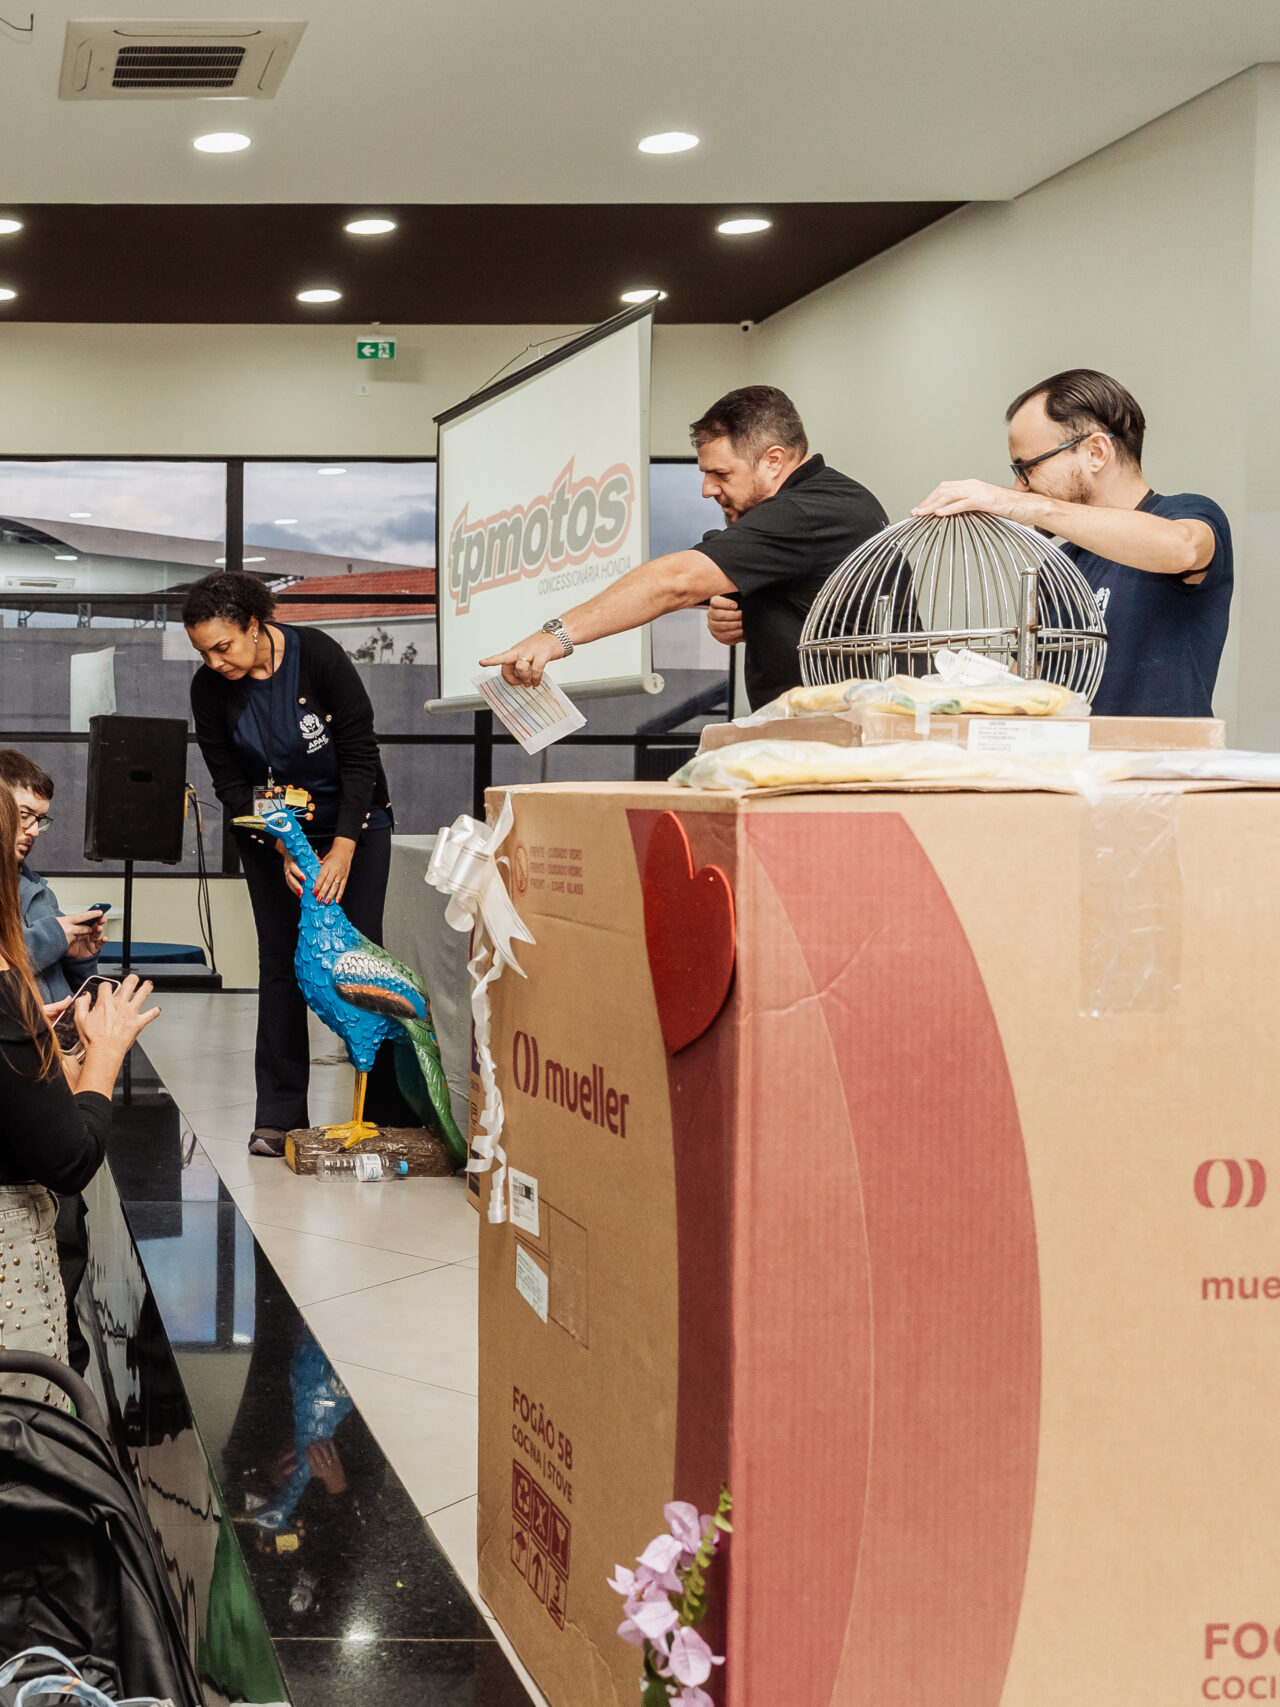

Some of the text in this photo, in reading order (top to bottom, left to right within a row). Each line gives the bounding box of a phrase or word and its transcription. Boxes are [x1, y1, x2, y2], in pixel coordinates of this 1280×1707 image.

[449, 460, 633, 612] tpmotos
[601, 556, 631, 578] HONDA
[545, 1058, 629, 1138] mueller
[1201, 1275, 1280, 1301] mue
[512, 1385, 555, 1450] FOGÃO
[511, 1424, 542, 1466] COCINA
[547, 1462, 573, 1504] STOVE
[1204, 1621, 1280, 1660] FO
[1201, 1675, 1276, 1700] COCI
